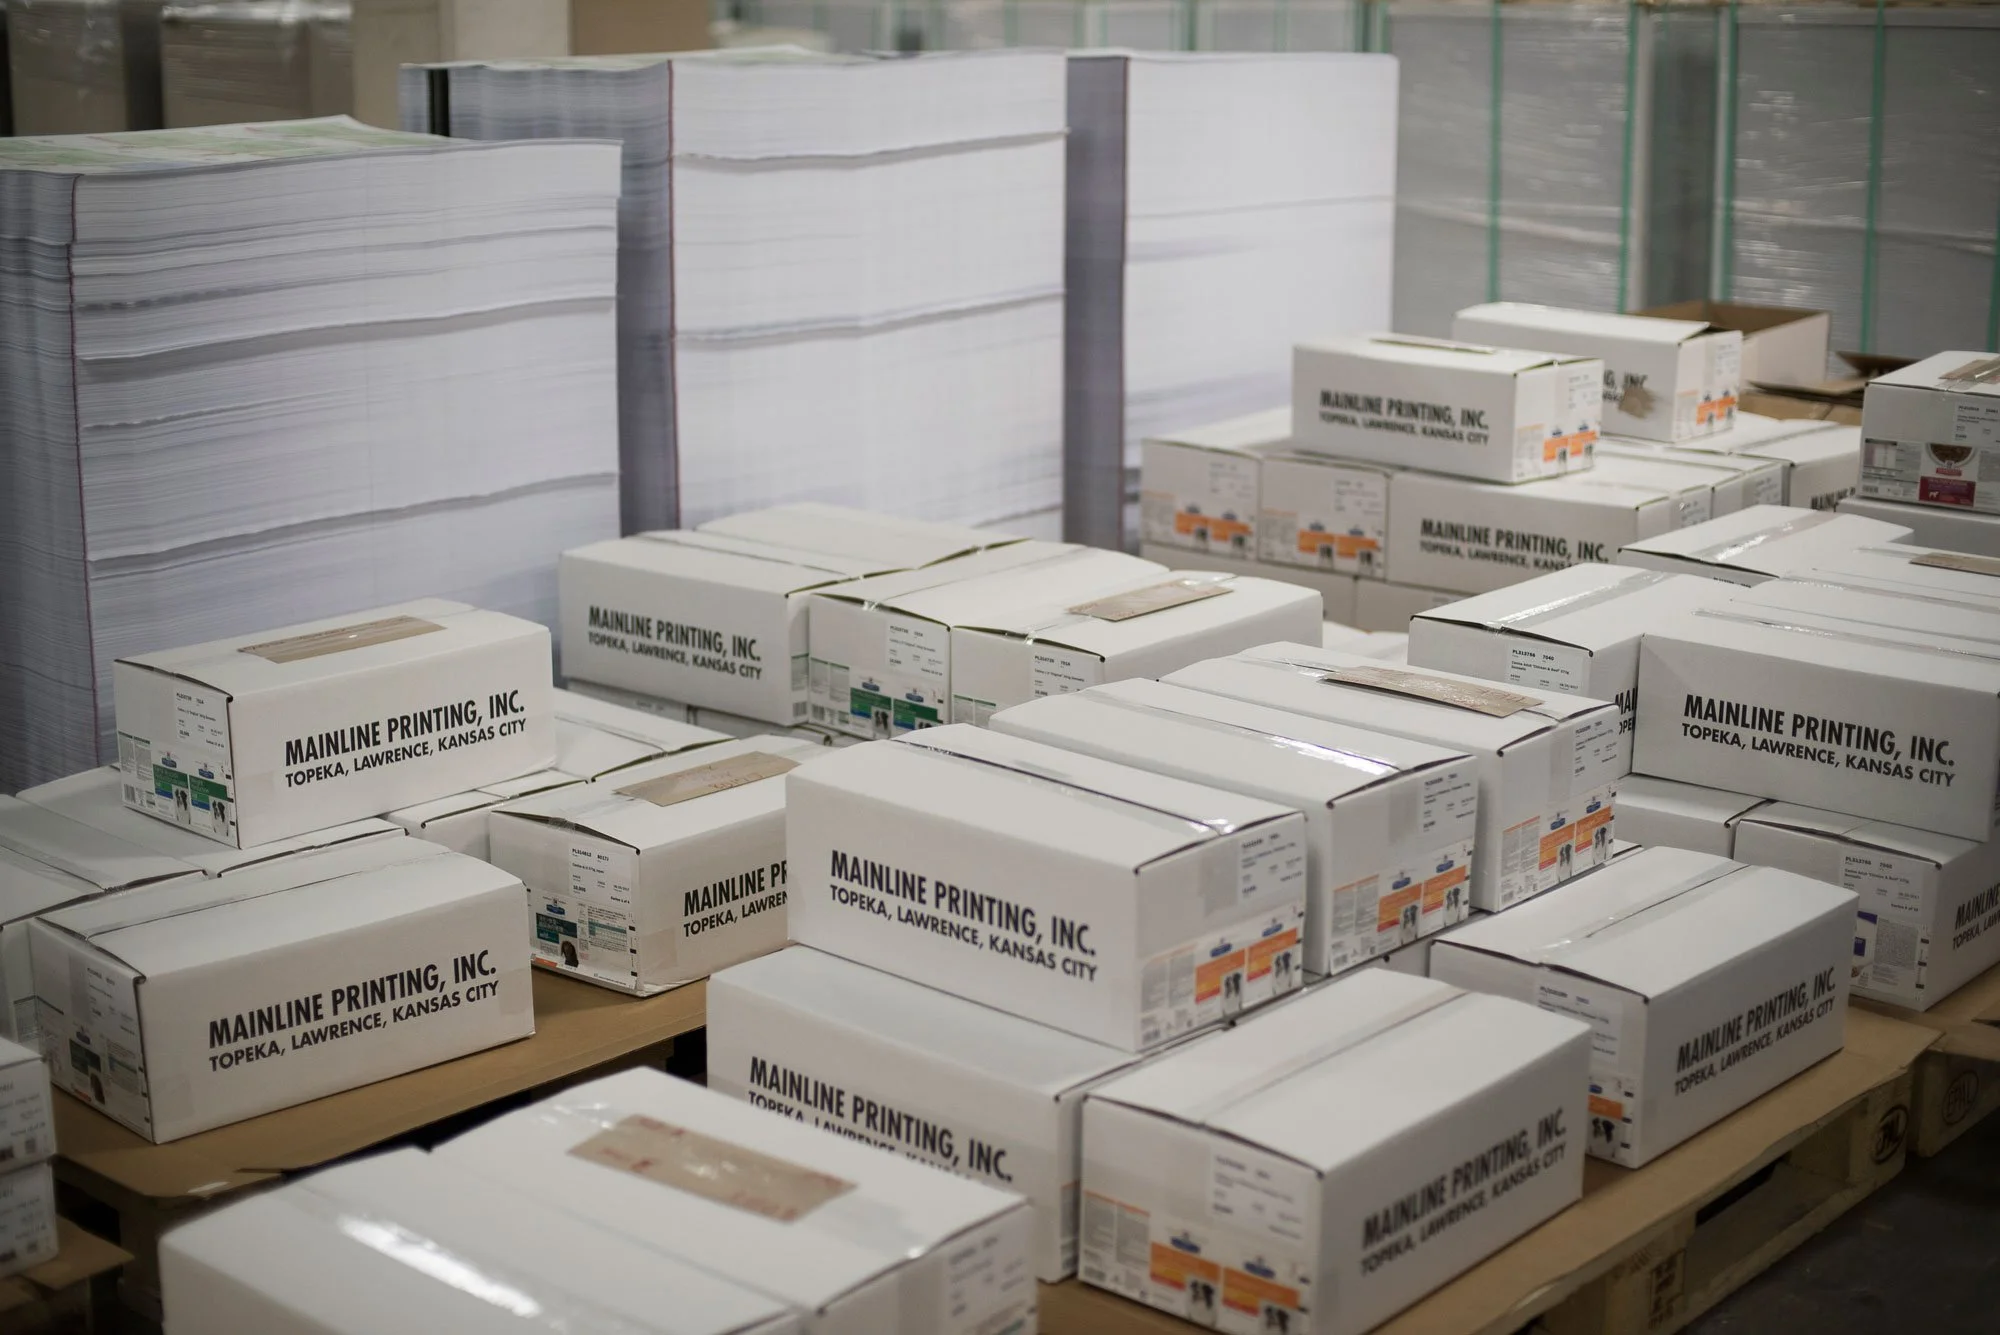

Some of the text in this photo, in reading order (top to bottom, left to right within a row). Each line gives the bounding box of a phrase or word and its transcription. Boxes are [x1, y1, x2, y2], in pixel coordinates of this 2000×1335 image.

[1319, 388, 1382, 416] MAINLINE
[1420, 518, 1609, 564] MAINLINE PRINTING, INC.
[588, 631, 762, 680] TOPEKA, LAWRENCE, KANSAS CITY
[589, 605, 761, 662] MAINLINE PRINTING, INC.
[285, 689, 525, 767] MAINLINE PRINTING, INC.
[285, 718, 527, 788] TOPEKA, LAWRENCE, KANSAS CITY
[1682, 722, 1956, 787] TOPEKA, LAWRENCE, KANSAS CITY
[1684, 694, 1785, 735] MAINLINE
[1791, 714, 1903, 759] PRINTING,
[1910, 735, 1955, 766] INC.
[683, 891, 788, 938] TOPEKA, LAWREN
[684, 867, 765, 917] MAINLINE
[831, 850, 927, 905] MAINLINE
[935, 881, 1043, 946] PRINTING,
[1051, 916, 1096, 956] INC.
[830, 884, 1097, 982] TOPEKA, LAWRENCE, KANSAS CITY
[209, 950, 497, 1049] MAINLINE PRINTING, INC.
[209, 981, 499, 1072] TOPEKA, LAWRENCE, KANSAS CITY
[1677, 1015, 1743, 1073] MAINLINE
[1746, 982, 1809, 1037] PRINTING,
[1813, 966, 1836, 1000] INC.
[1674, 996, 1836, 1096] TOPEKA, LAWRENCE, KANSAS CITY
[749, 1091, 804, 1122] TOPEKA
[750, 1056, 845, 1118] MAINLINE
[852, 1095, 960, 1167] PRINTING,
[968, 1138, 1013, 1182] INC.
[1363, 1174, 1447, 1249] MAINLINE
[1452, 1129, 1532, 1198] PRINTING,
[1537, 1106, 1567, 1148] INC.
